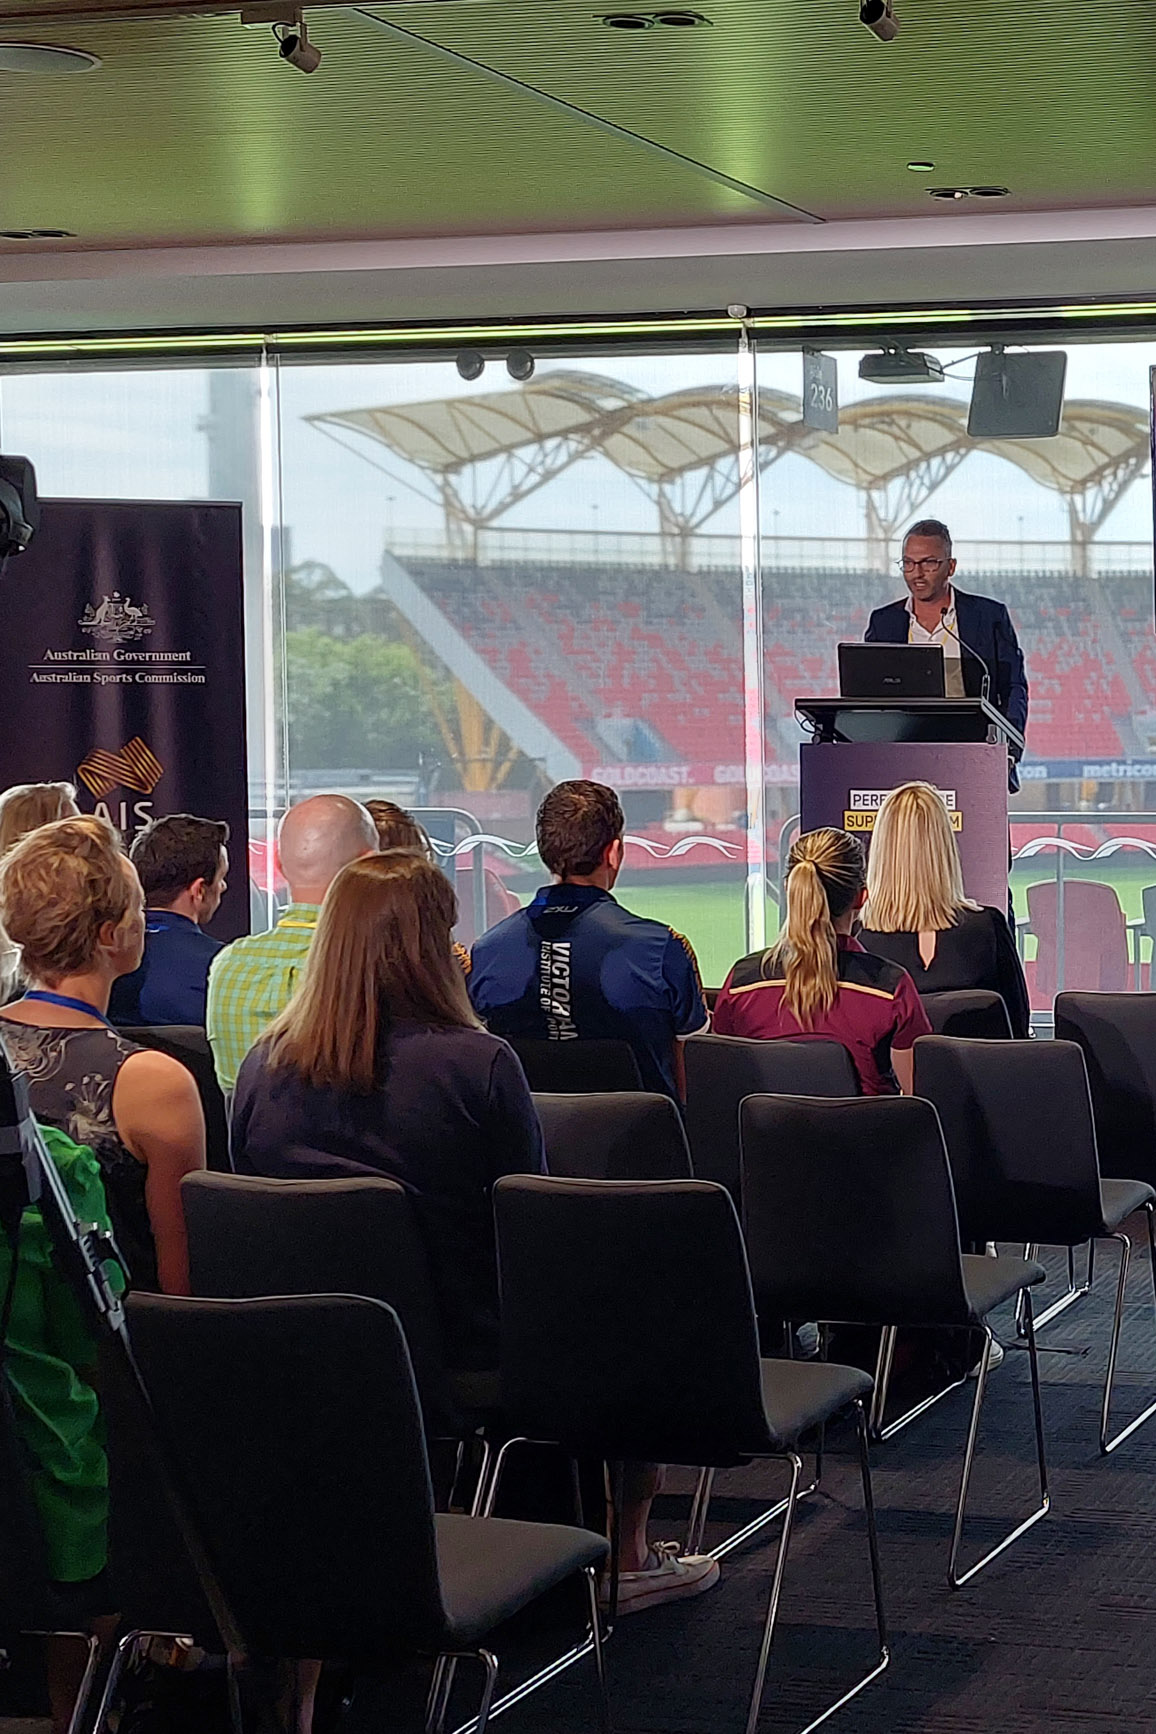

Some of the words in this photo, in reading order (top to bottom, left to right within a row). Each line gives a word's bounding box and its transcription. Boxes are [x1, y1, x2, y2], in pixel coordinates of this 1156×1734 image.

[810, 383, 833, 412] 236
[43, 649, 110, 662] Australian
[113, 649, 192, 662] Government
[30, 672, 91, 684] Australian
[93, 672, 133, 686] Sports
[135, 672, 206, 684] Commission
[92, 801, 154, 831] AIS
